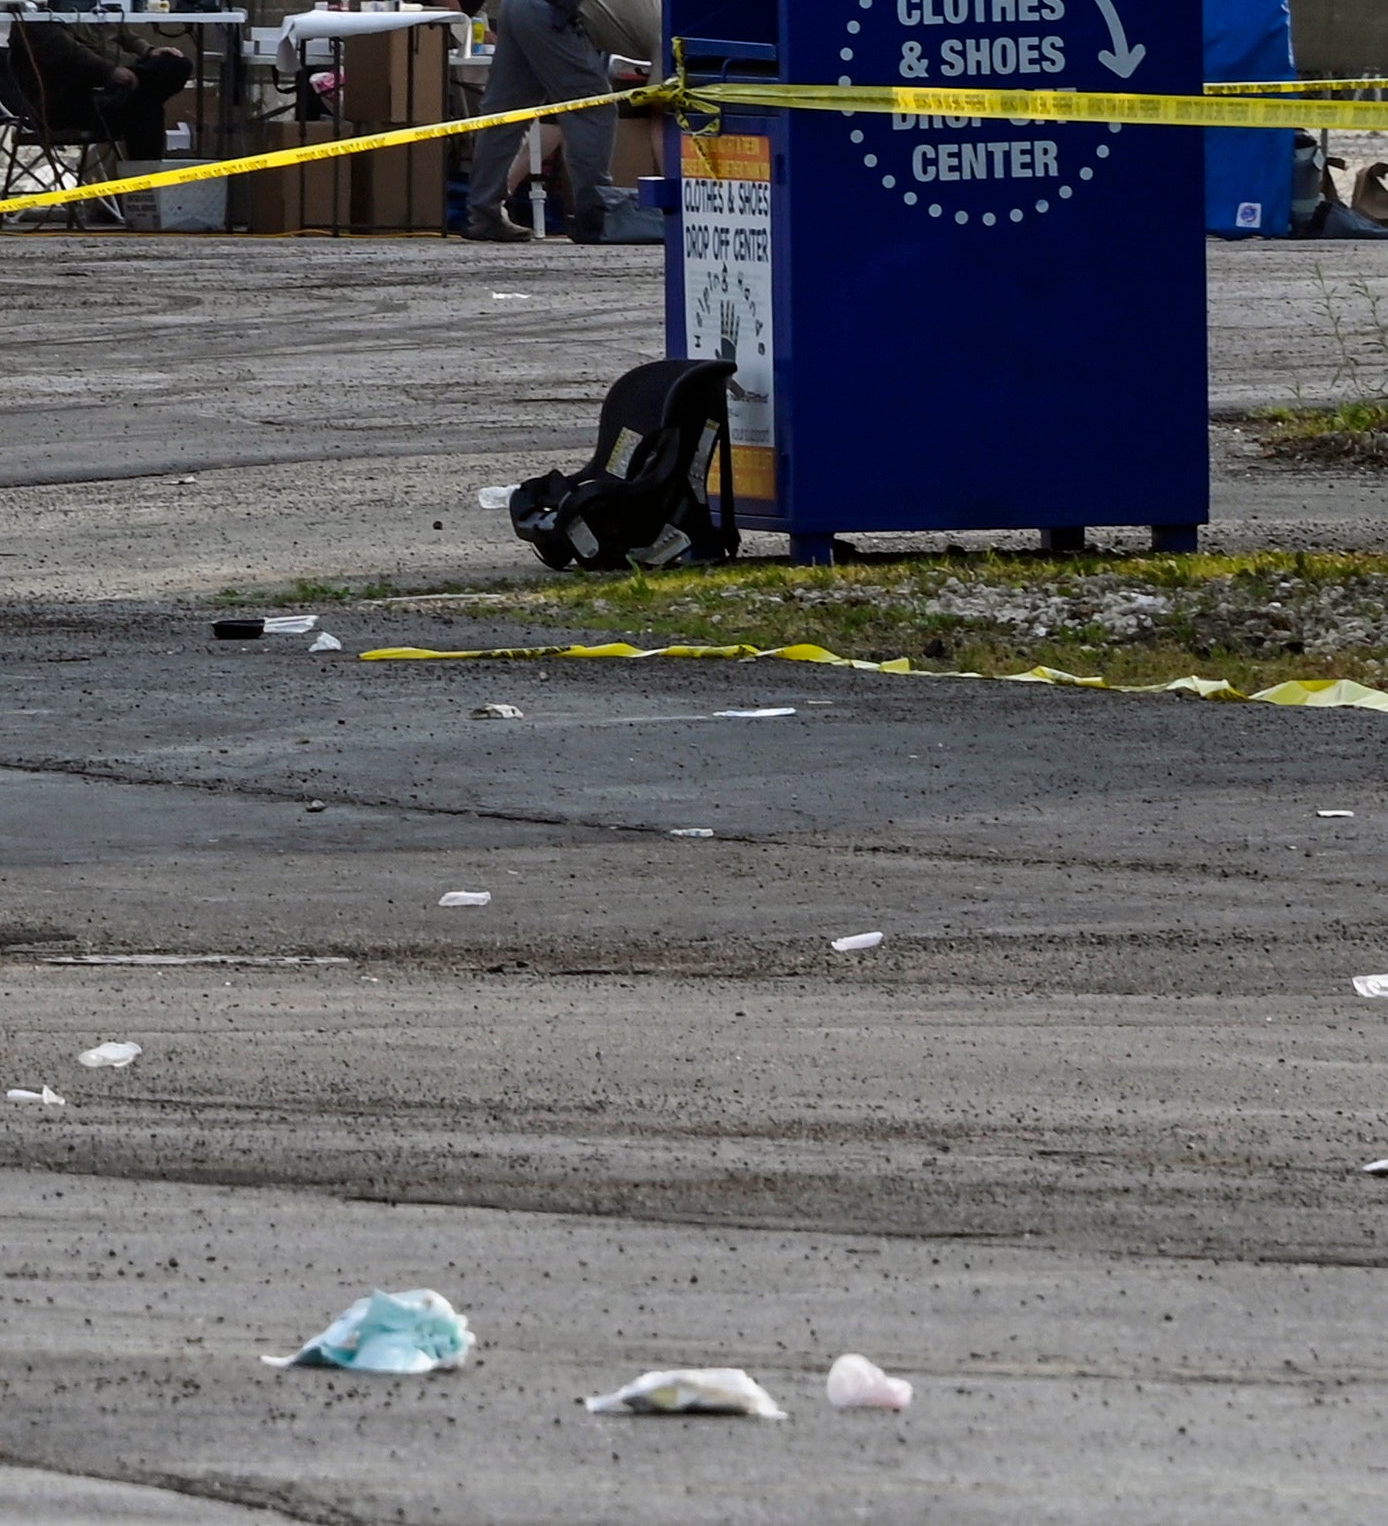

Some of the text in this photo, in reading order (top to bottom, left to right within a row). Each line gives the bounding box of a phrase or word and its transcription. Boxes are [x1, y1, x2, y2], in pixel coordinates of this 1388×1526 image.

[898, 36, 1066, 79] & SHOES
[912, 140, 1059, 182] CENTER
[684, 179, 724, 215] CLOTHES
[727, 181, 735, 214] &
[738, 182, 769, 216] SHOES
[685, 224, 769, 263] DROP OFF CENTER
